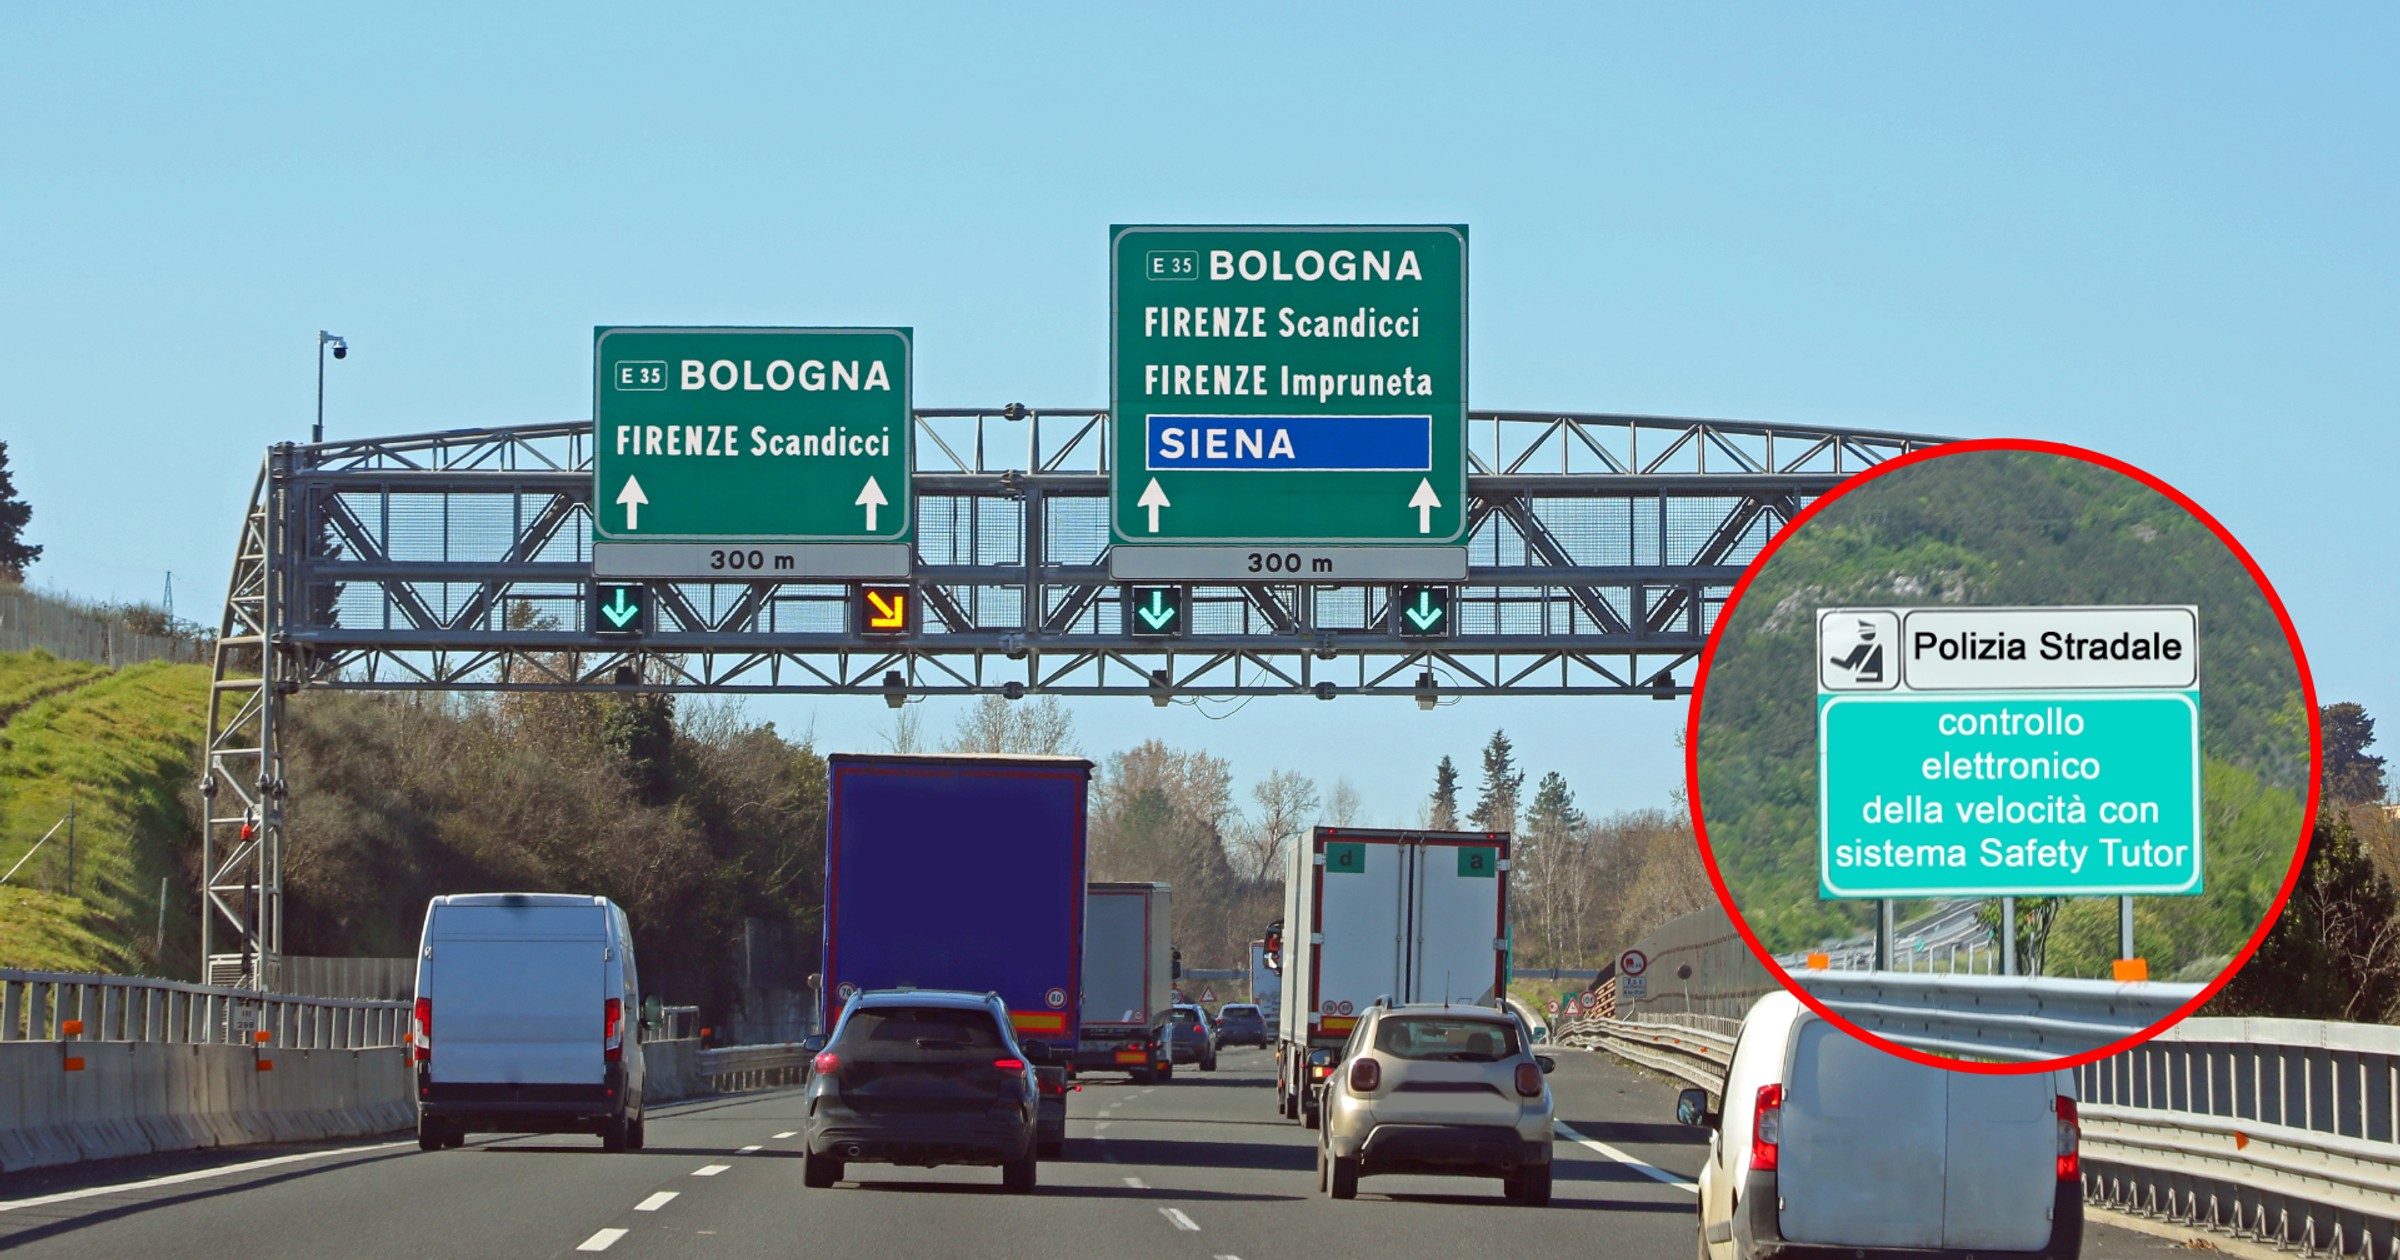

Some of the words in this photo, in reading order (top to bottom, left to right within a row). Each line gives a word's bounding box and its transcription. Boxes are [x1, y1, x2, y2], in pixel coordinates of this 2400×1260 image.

[1153, 257, 1164, 273] E
[1172, 257, 1192, 273] 35
[1210, 250, 1422, 281] BOLOGNA
[1145, 306, 1267, 337] FIRENZE
[1278, 307, 1419, 337] Scandicci
[622, 368, 633, 384] E
[640, 367, 660, 384] 35
[681, 359, 891, 391] BOLOGNA
[1145, 364, 1268, 395] FIRENZE
[1281, 365, 1433, 404] Impruneta
[617, 425, 739, 456] FIRENZE
[750, 425, 889, 456] Scandicci
[1159, 427, 1295, 459] SIENA
[710, 550, 764, 570] 300
[774, 556, 795, 570] m
[1247, 552, 1302, 573] 300
[1312, 558, 1333, 573] m
[1914, 631, 2026, 661] Polizia
[2039, 631, 2182, 661] Stradale
[1938, 707, 2085, 736] controllo
[1922, 751, 2100, 780] elettronico
[1862, 795, 1943, 824] della
[1956, 794, 2086, 824] velocità
[2099, 801, 2159, 824] con
[1339, 850, 1353, 867] d
[1469, 853, 1484, 870] a
[1836, 838, 1966, 867] sistema
[1980, 837, 2089, 874] Safety
[2099, 838, 2188, 867] Tutor
[1051, 993, 1062, 1003] 80
